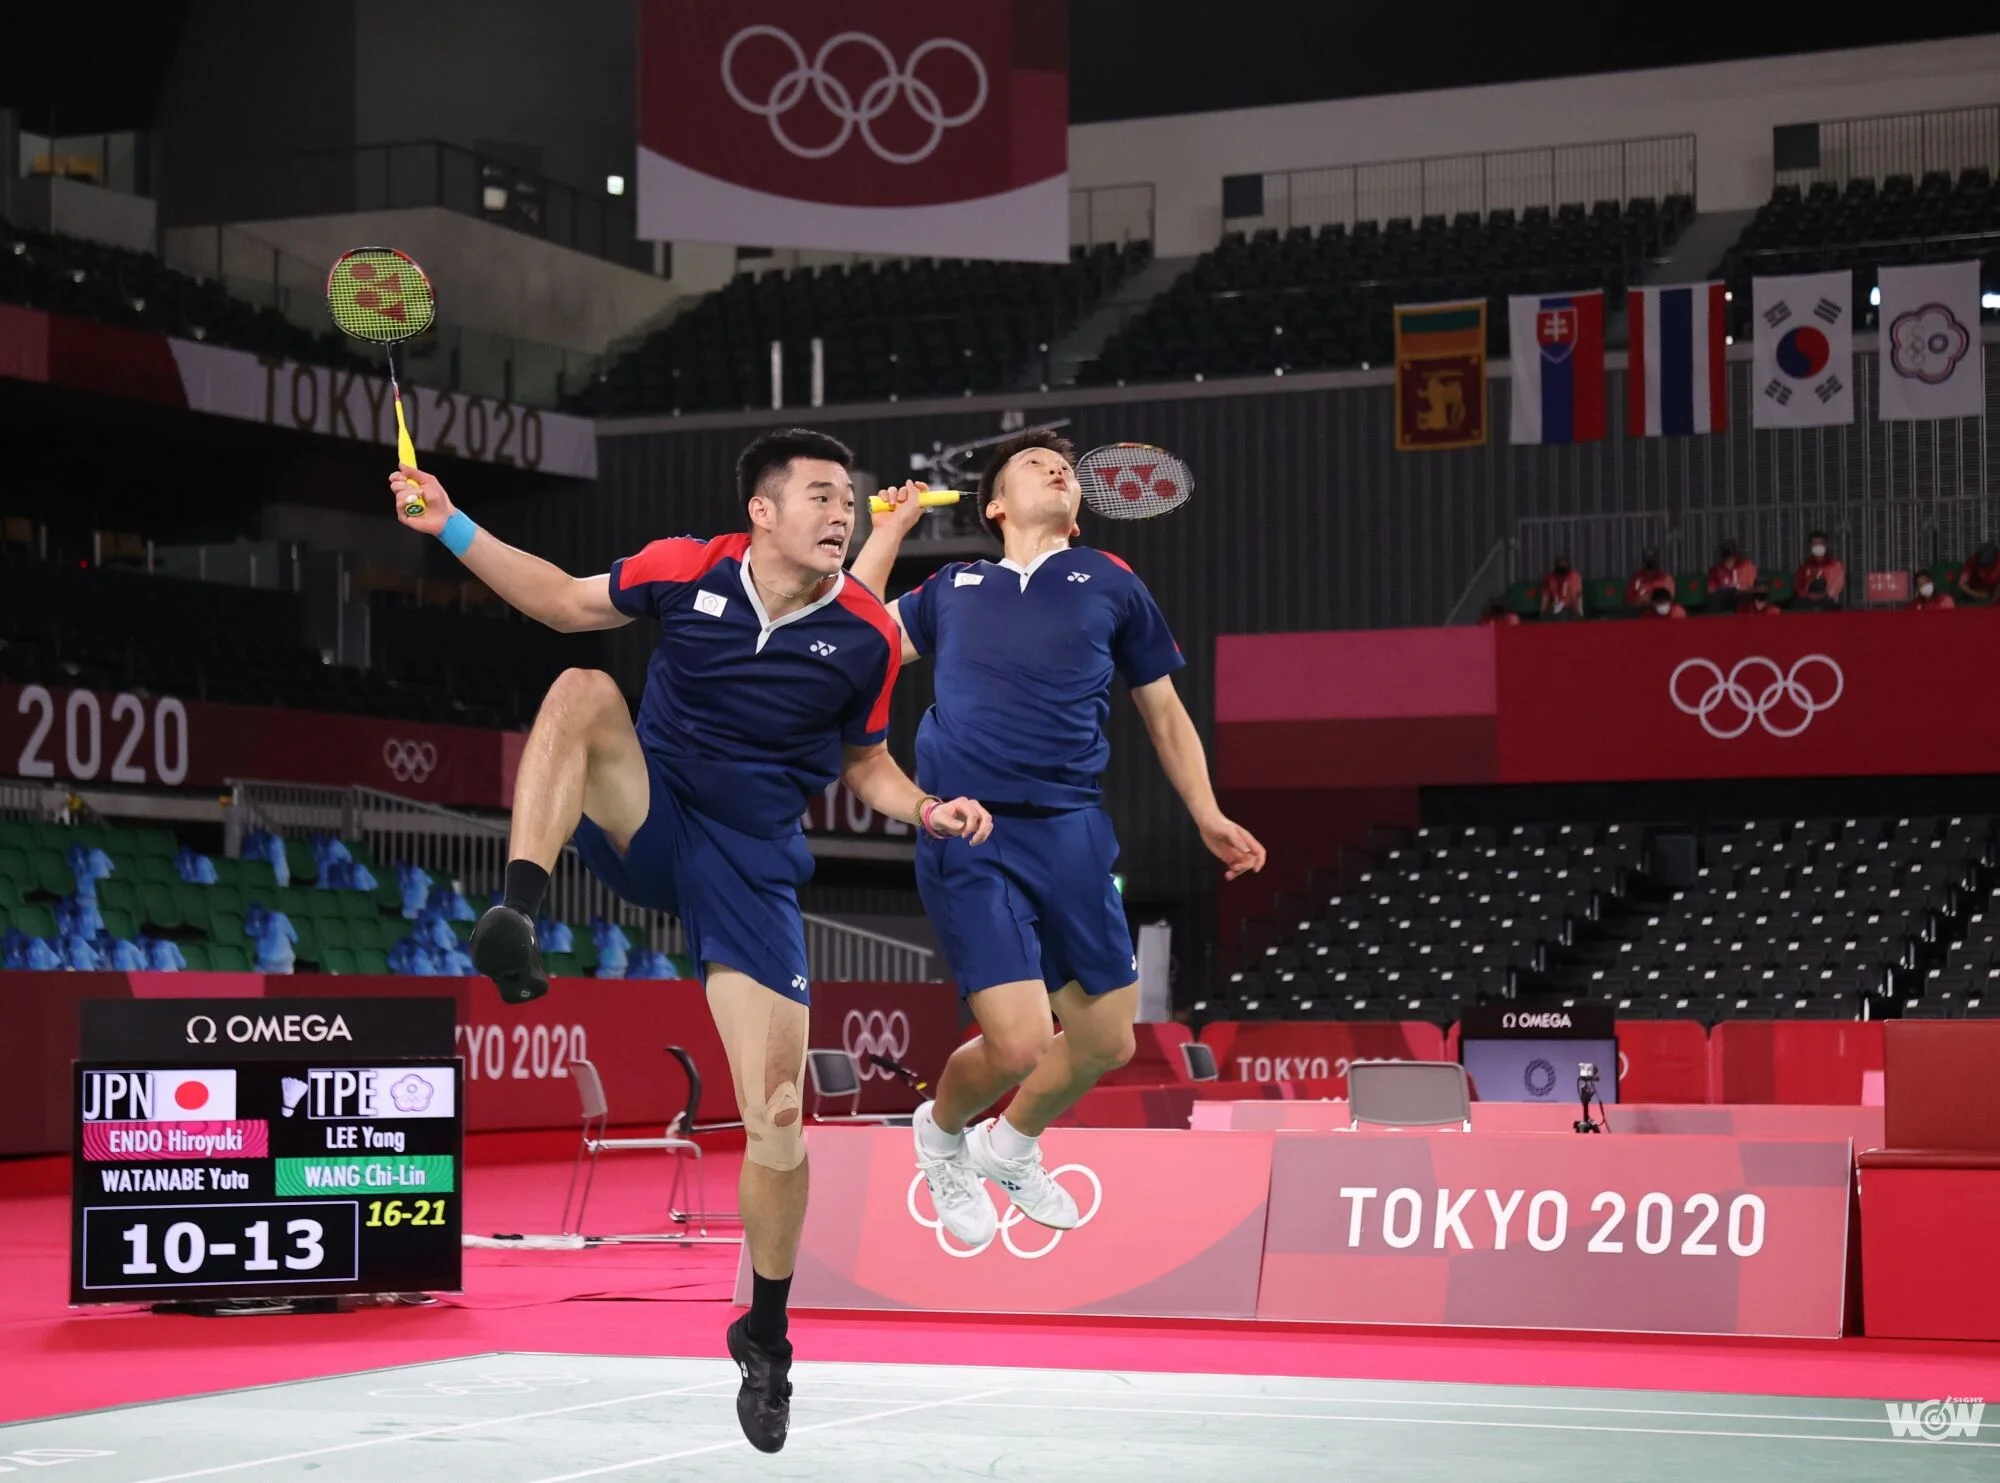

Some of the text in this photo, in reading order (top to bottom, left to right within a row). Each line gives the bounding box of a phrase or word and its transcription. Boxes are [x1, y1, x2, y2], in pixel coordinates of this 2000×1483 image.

[257, 355, 543, 470] TOKYO 2020
[18, 684, 189, 786] 2020
[226, 1014, 353, 1043] OMEGA
[1518, 1012, 1572, 1029] OMEGA
[455, 1024, 587, 1080] YO 2020
[1237, 1056, 1329, 1082] TOKYO
[83, 1073, 153, 1120] JPN
[310, 1070, 377, 1117] TPE
[109, 1127, 243, 1157] ENDO Hiroyuki
[326, 1126, 405, 1152] LEE Yang
[101, 1167, 249, 1192] WATANABE Yuta
[304, 1164, 426, 1188] WANG Chi-Lin
[365, 1200, 446, 1227] 16-21
[1339, 1187, 1766, 1256] TOKYO 2020
[121, 1219, 325, 1275] 10-13
